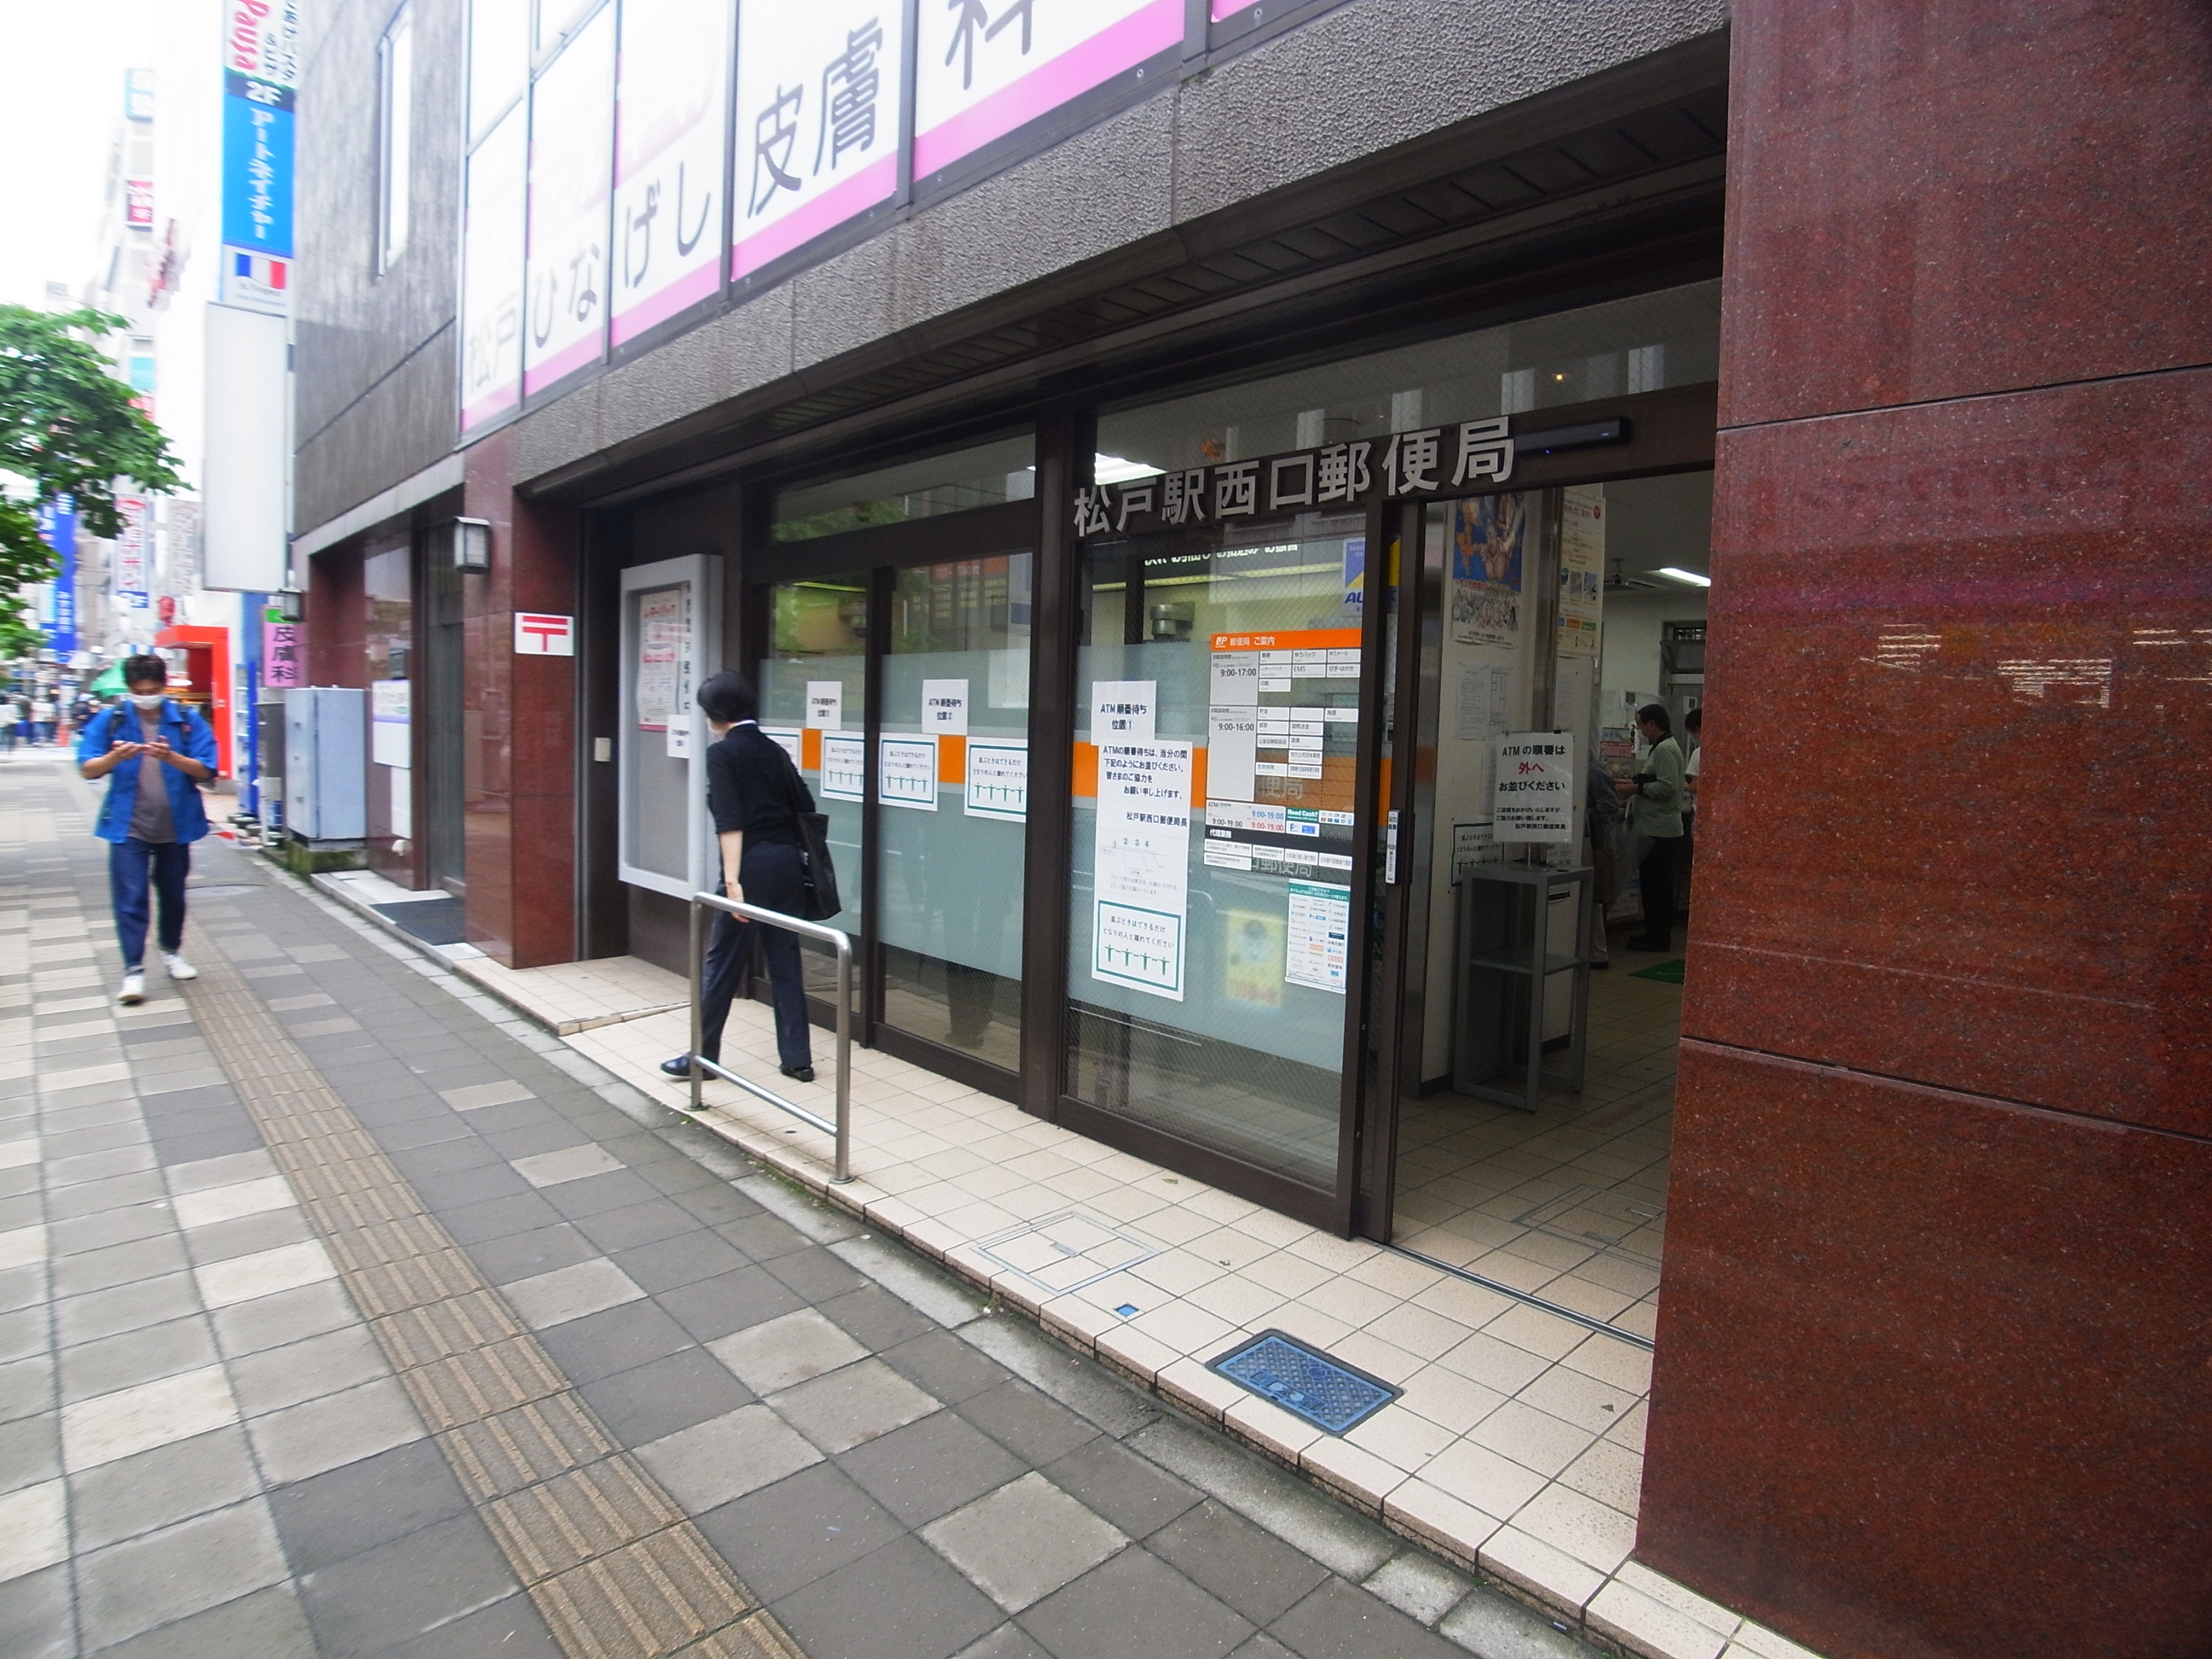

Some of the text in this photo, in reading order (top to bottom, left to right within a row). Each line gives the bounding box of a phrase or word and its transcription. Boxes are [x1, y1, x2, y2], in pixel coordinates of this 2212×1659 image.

[246, 81, 283, 106] 2F
[247, 107, 276, 240] アートネイチャー
[1073, 416, 1515, 536] 松戸駅西口郵便局
[1229, 637, 1250, 646] 郵便局
[1254, 636, 1275, 646] ご案内
[1221, 668, 1256, 677] 9:00-17:00
[1101, 703, 1147, 714] ATM 順番待ち
[1218, 722, 1254, 731] 9:00-16:00
[1502, 745, 1565, 757] ATM の順番は
[1104, 758, 1185, 773] 下記のようにお並びください。
[1518, 762, 1544, 775] 外へ
[1499, 781, 1565, 792] お並びください
[1124, 786, 1183, 800] お願い申し上げます。
[1252, 811, 1284, 819] 9:00-19:00
[1302, 810, 1318, 818] Cash?
[1212, 817, 1243, 827] 9:00-19:00
[1251, 821, 1284, 832] 9:00-19:00
[1111, 916, 1166, 933] 並ぶときはできるだけ
[1103, 928, 1174, 949] となりの人と離れてください
